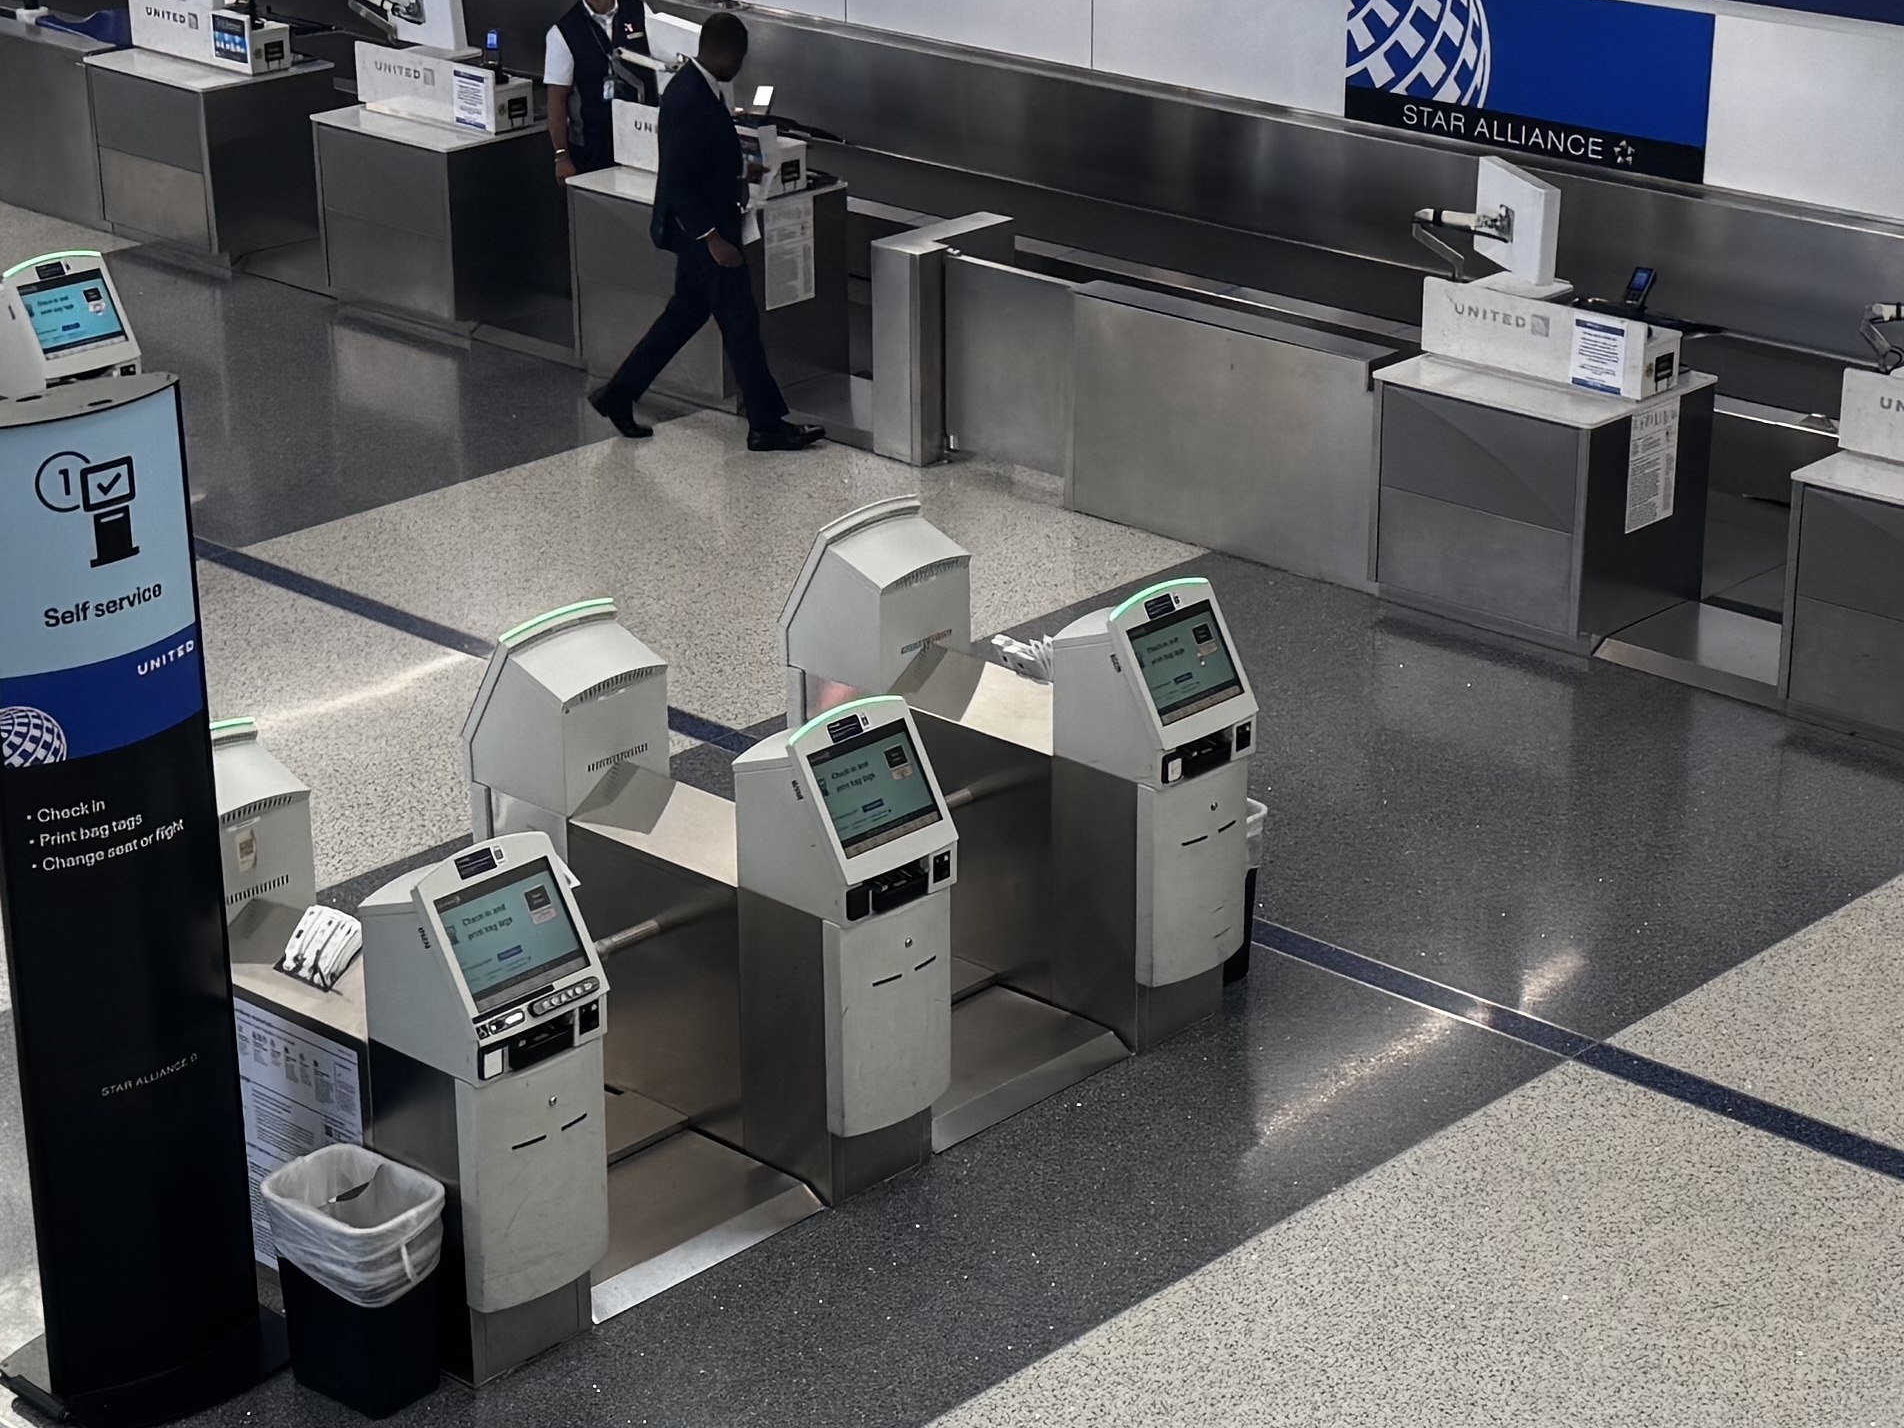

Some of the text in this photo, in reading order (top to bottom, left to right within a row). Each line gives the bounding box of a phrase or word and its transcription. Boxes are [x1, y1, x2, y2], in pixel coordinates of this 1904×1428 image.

[145, 5, 187, 25] UNITED
[373, 59, 422, 80] UNITED
[1402, 103, 1604, 160] STAR ALLIANCE
[1453, 301, 1527, 329] UNITED
[43, 581, 163, 629] Self service
[135, 638, 196, 676] UNITED
[36, 796, 107, 824] Check in
[38, 811, 144, 848] Print bag tags
[42, 848, 106, 875] Change
[106, 838, 139, 862] seat
[140, 833, 155, 849] or
[101, 1057, 189, 1097] STAR ALLIANCE
